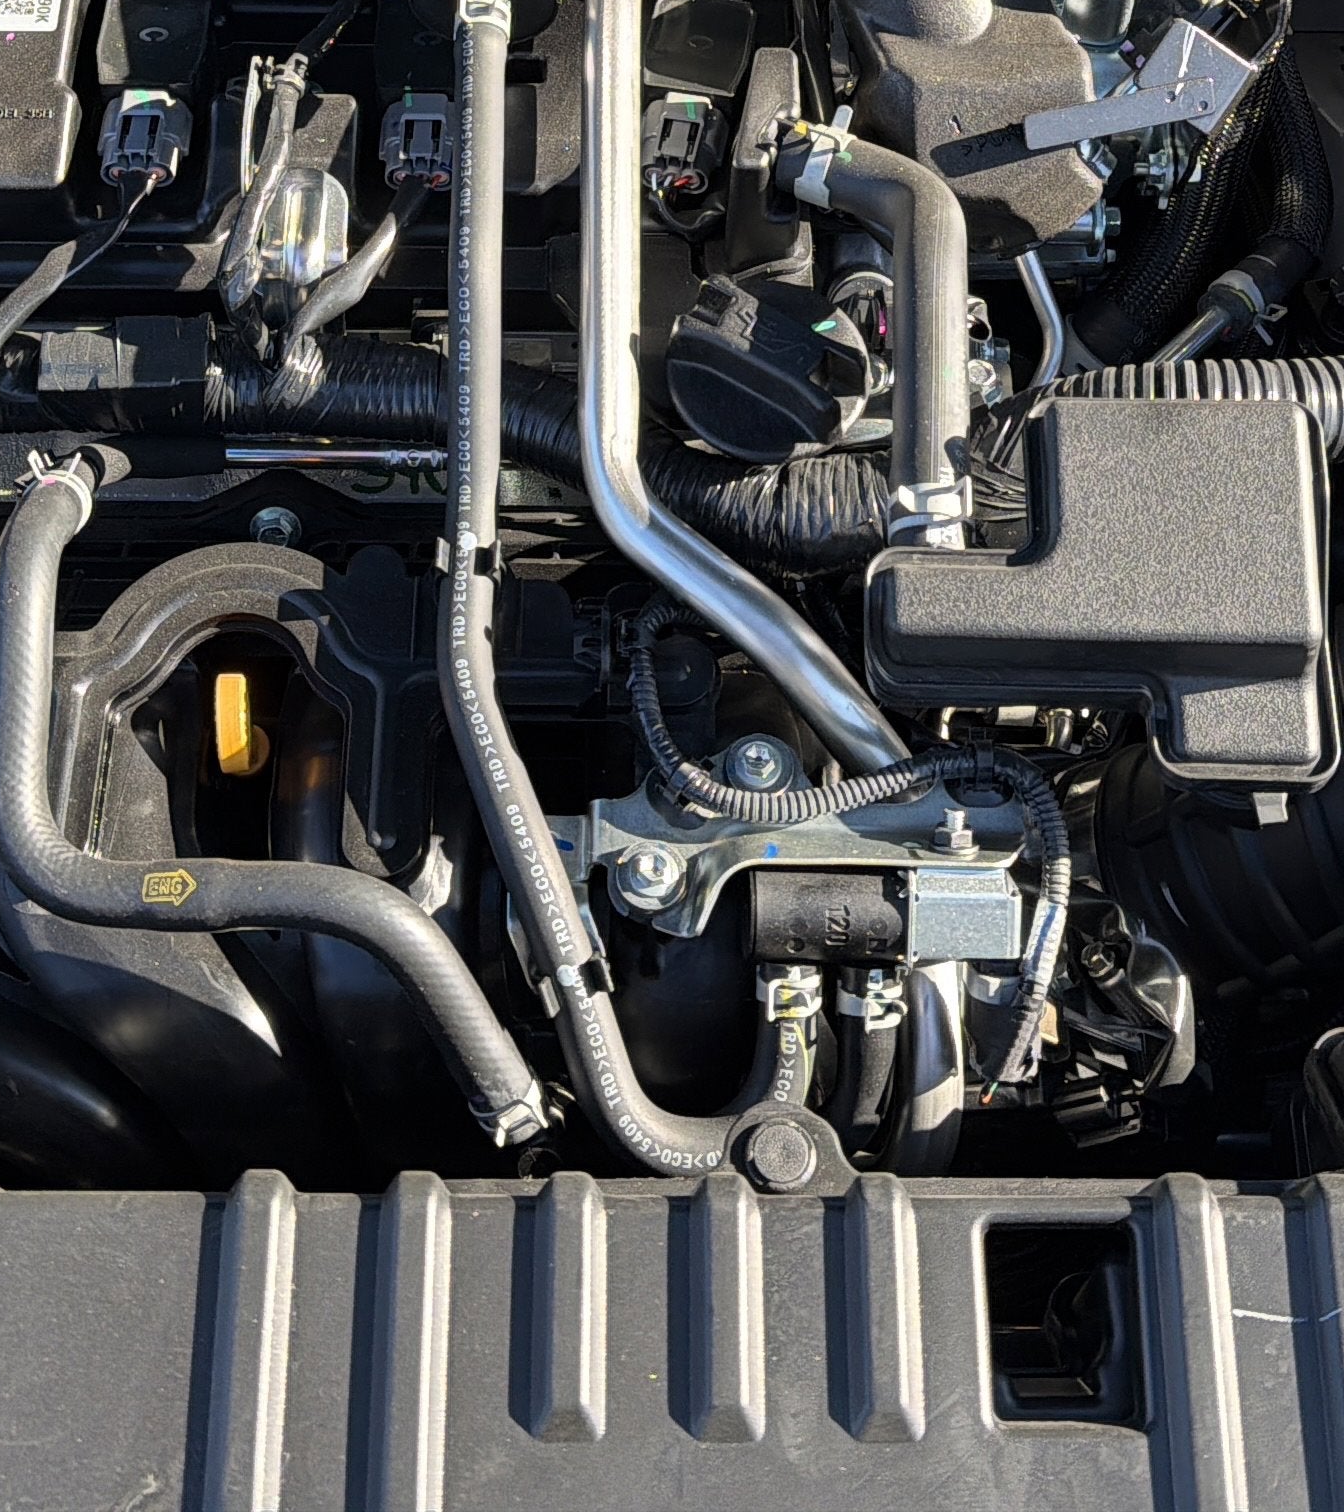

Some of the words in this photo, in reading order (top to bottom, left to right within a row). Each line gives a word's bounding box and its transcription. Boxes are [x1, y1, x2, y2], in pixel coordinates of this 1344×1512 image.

[452, 521, 470, 648] TRD>ECO<509
[454, 658, 511, 794] TRD>ECO<5409
[148, 877, 183, 896] ENG
[506, 804, 575, 957] TRD>ECO<5409
[617, 1114, 723, 1169] D>ECO<5409
